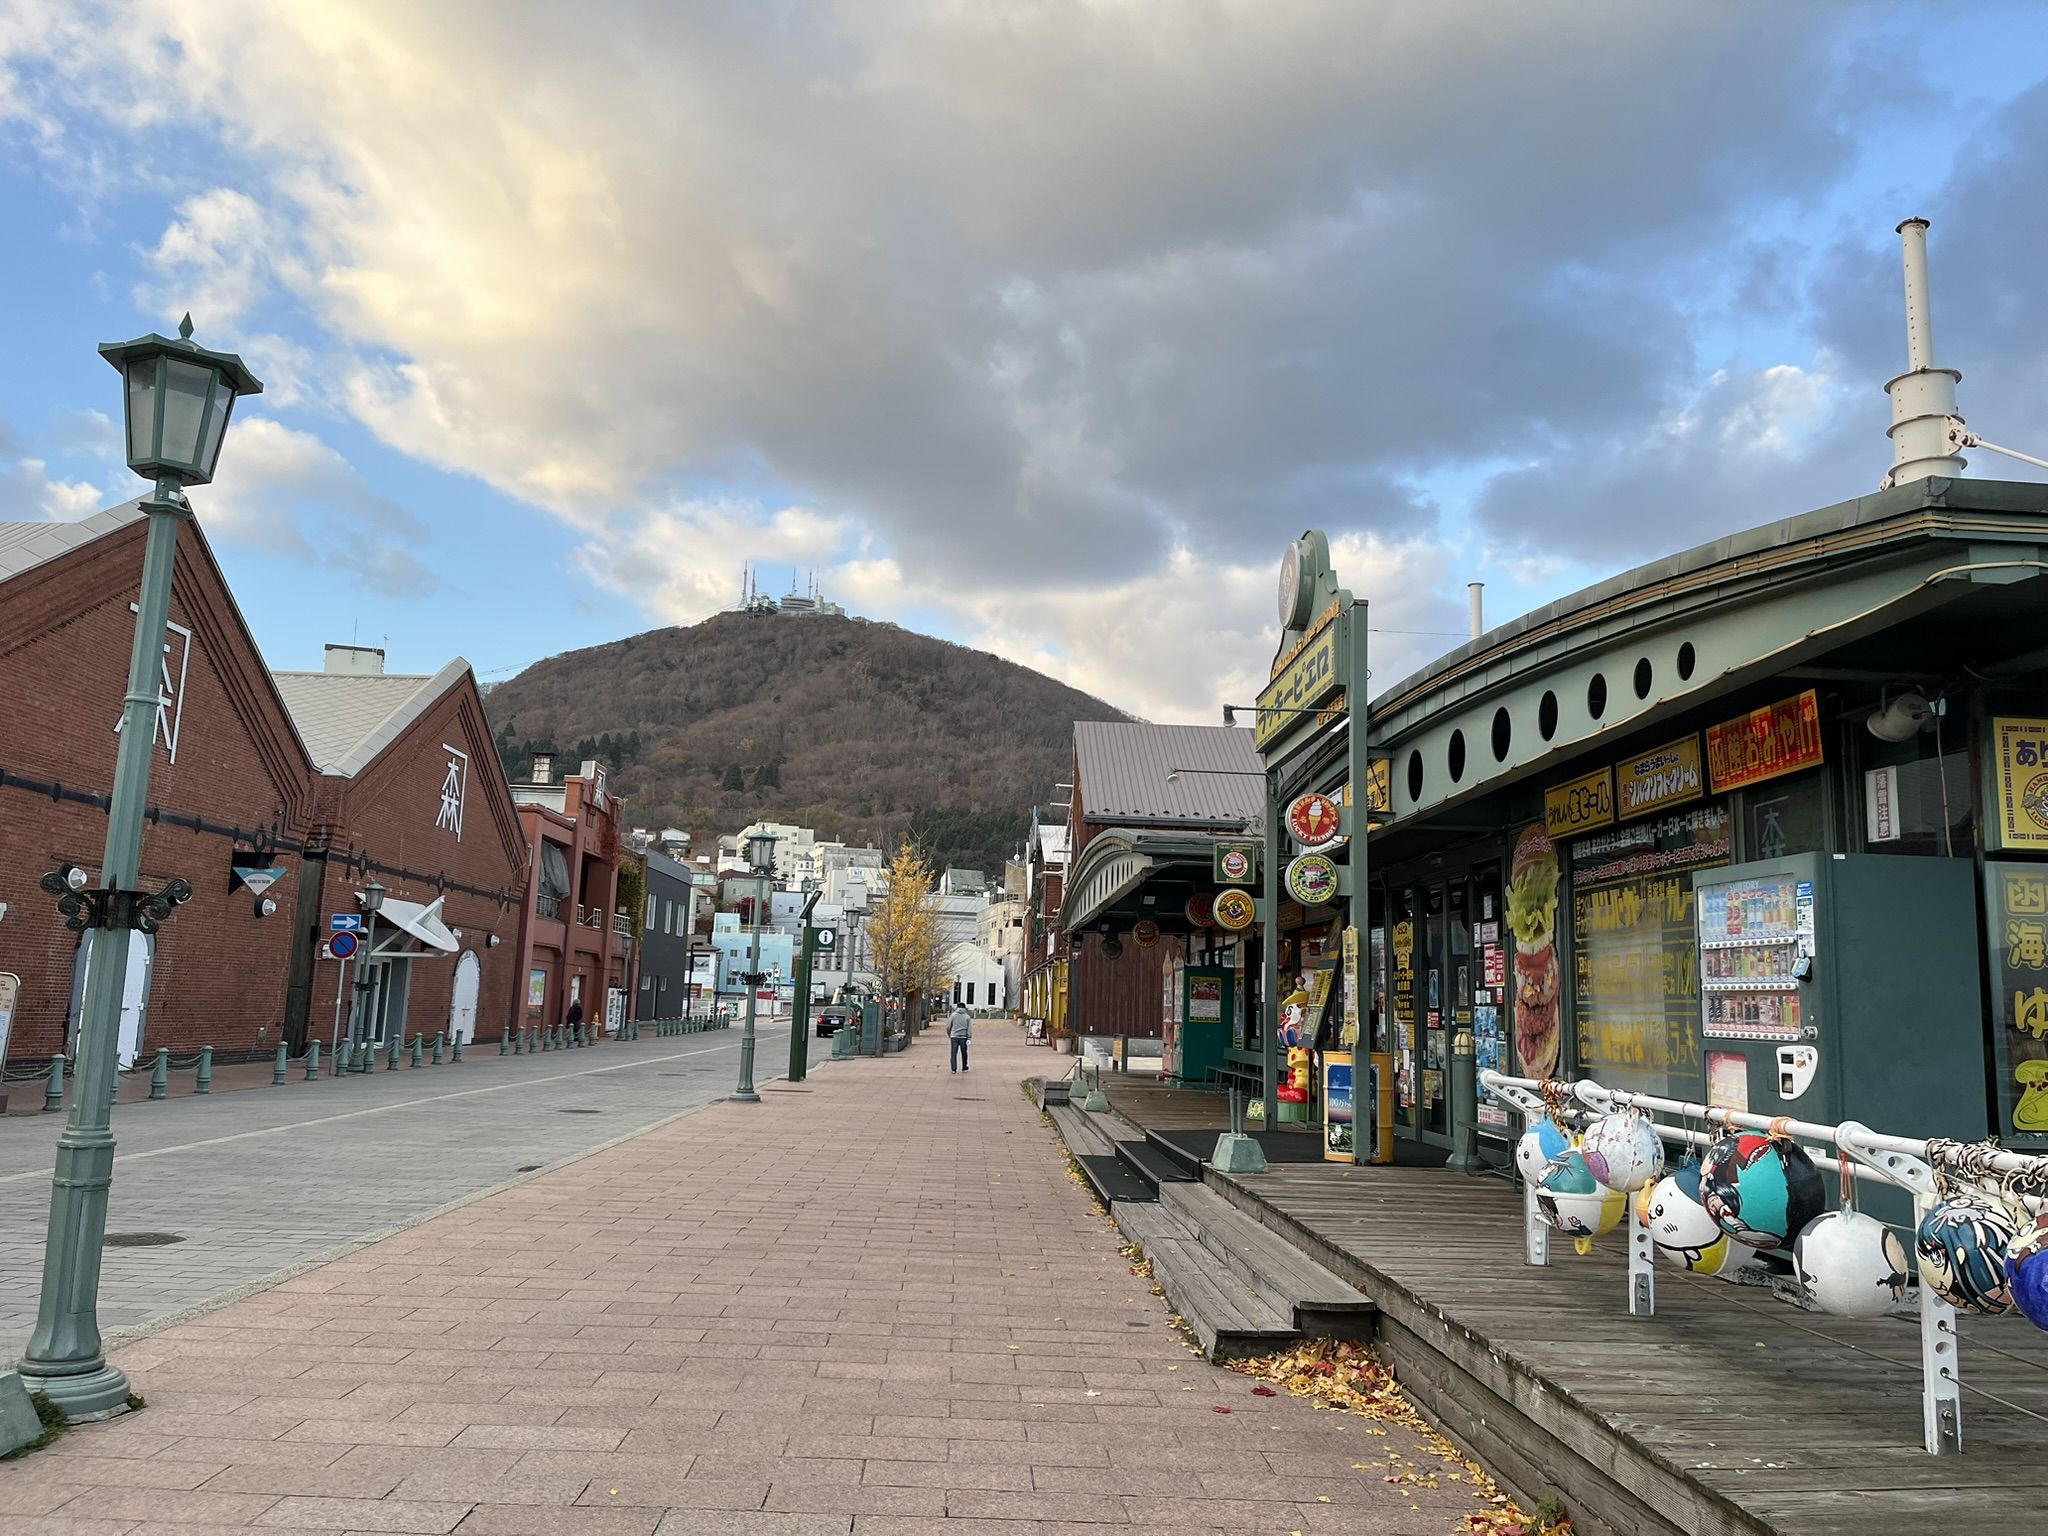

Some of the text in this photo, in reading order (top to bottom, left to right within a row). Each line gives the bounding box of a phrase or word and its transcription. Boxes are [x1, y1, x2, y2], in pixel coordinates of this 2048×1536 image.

[1258, 645, 1329, 734] ラッキーピエロ
[1711, 704, 1817, 781] 函館おみやげ
[1292, 818, 1337, 842] LUCKY PIERROT
[1876, 770, 1890, 839] 落雪注意
